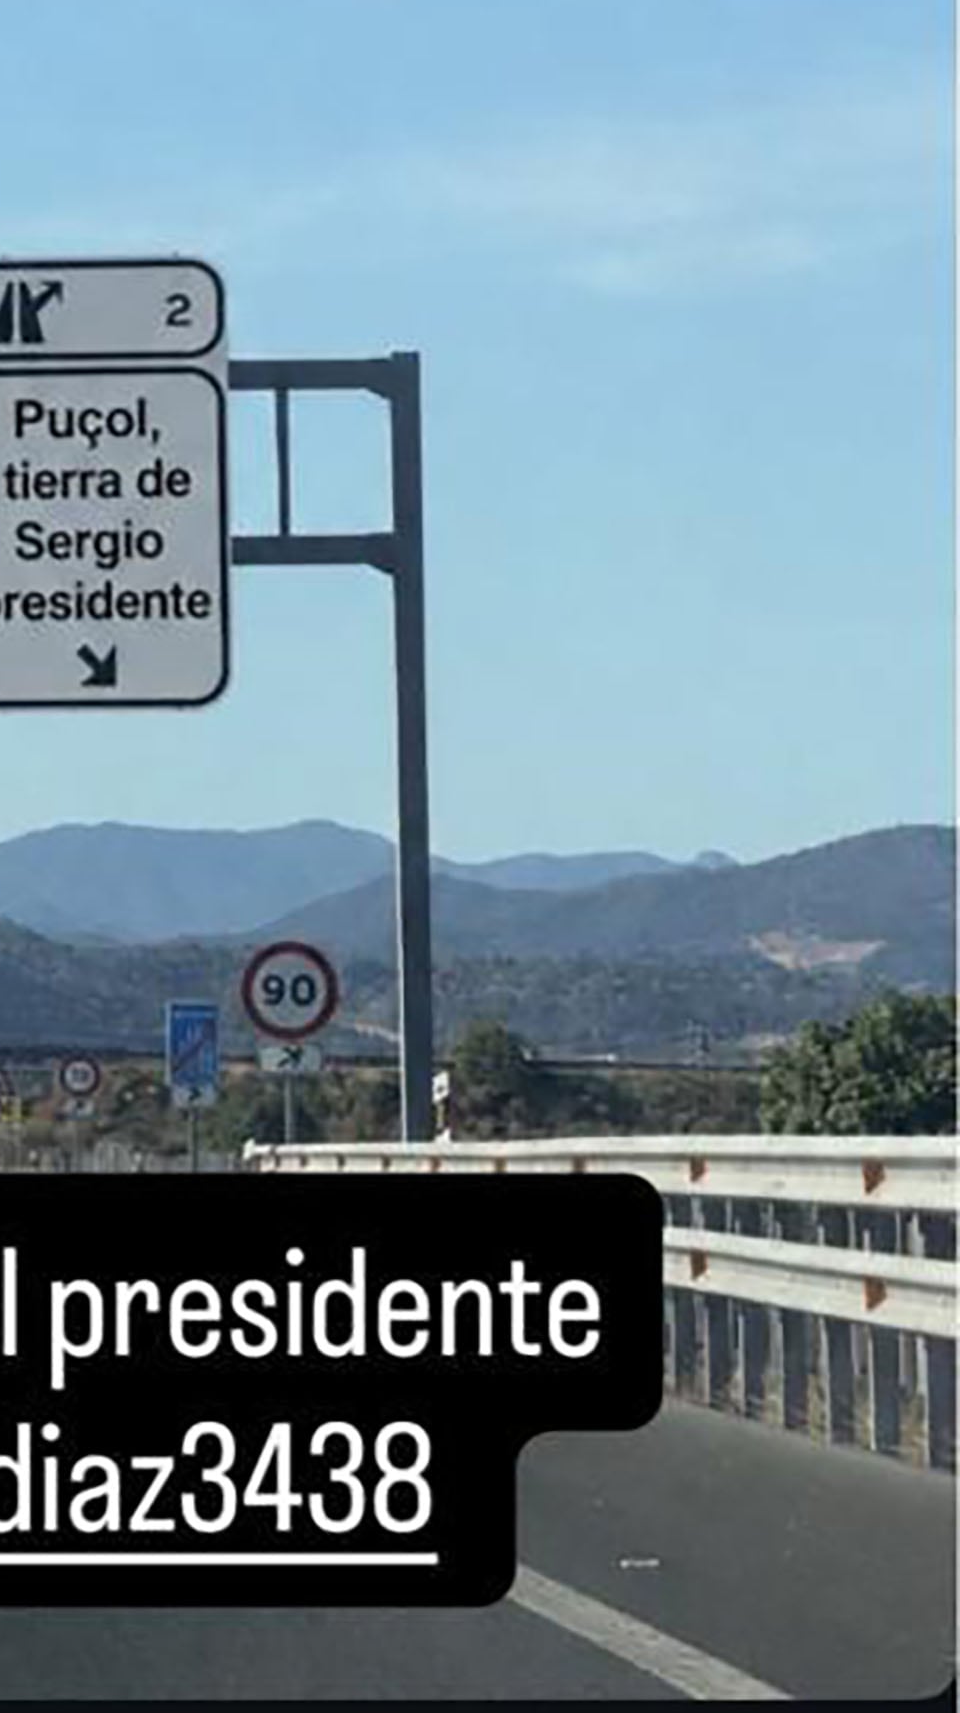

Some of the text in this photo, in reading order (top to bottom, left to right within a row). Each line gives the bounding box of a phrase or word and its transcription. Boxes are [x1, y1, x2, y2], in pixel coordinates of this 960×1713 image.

[165, 293, 192, 328] 2
[14, 398, 160, 449] Puçol,
[3, 458, 191, 500] tierra de
[15, 519, 164, 570] Sergio
[262, 973, 317, 1007] 90
